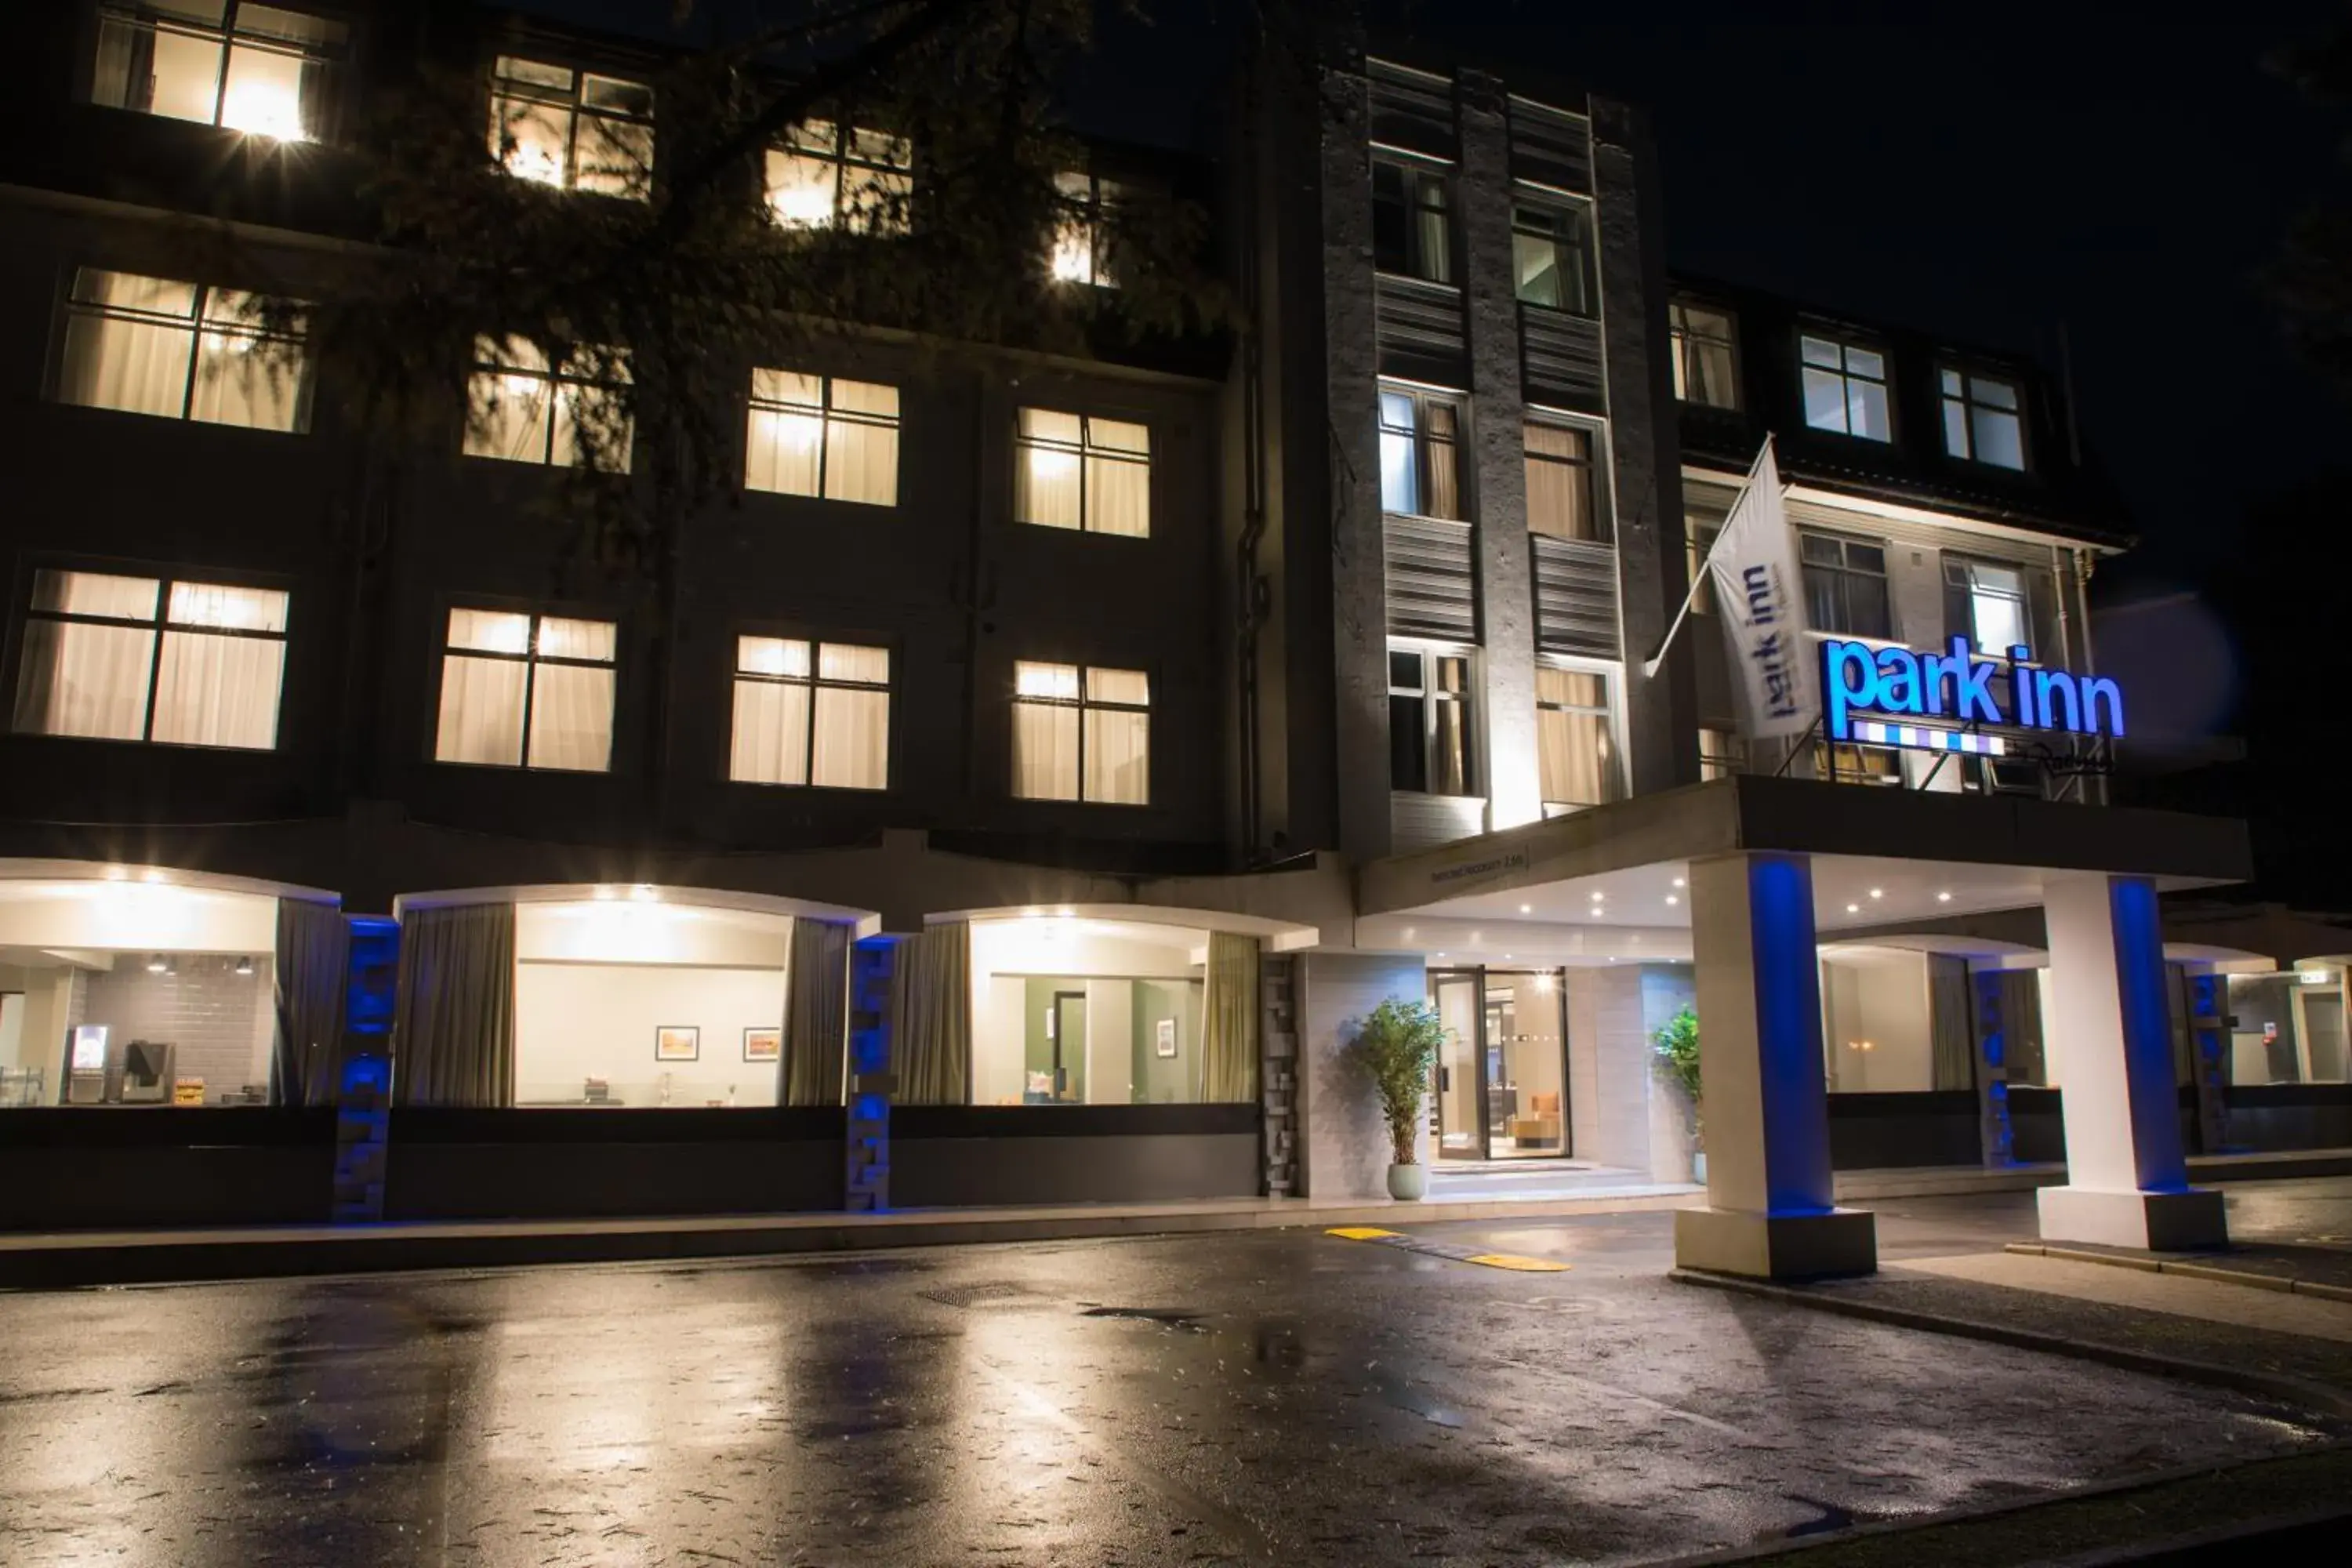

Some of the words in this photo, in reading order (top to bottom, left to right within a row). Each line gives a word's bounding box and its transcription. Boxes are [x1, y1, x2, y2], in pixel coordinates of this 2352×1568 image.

[1743, 564, 1775, 626] inn
[1820, 635, 2002, 739] park
[2008, 645, 2125, 737] inn
